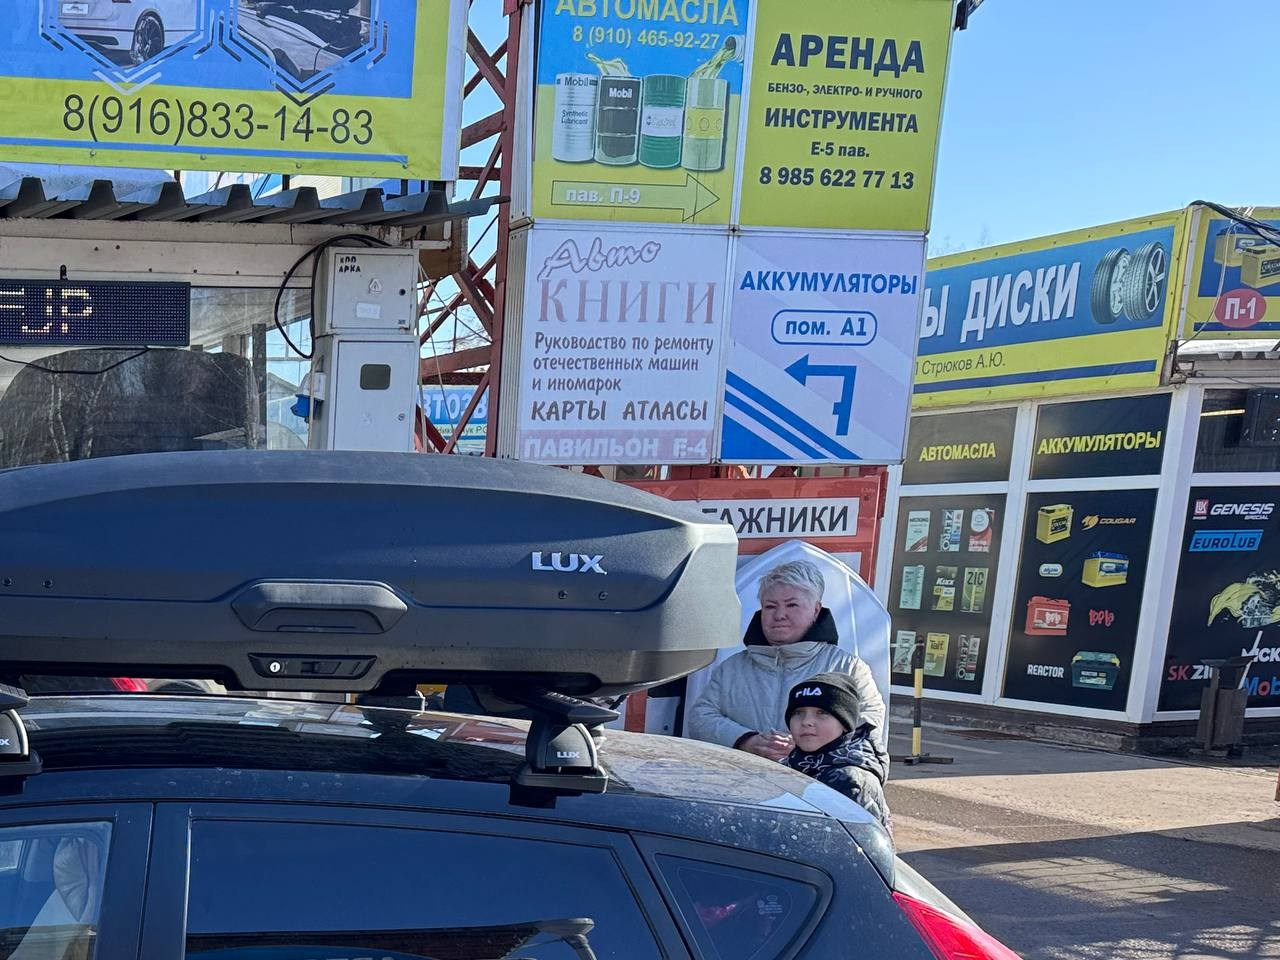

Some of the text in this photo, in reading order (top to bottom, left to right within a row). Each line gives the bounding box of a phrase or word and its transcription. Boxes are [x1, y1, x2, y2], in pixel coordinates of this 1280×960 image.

[555, 0, 739, 26] АВТОМАСЛА
[573, 25, 720, 49] 8 (910) 465-92-27
[770, 33, 925, 78] АРЕНДА
[564, 76, 588, 87] Mobil
[767, 83, 923, 99] БЕНЗО-, ЭЛЕКТРО- И РУЧНОГО
[609, 88, 633, 98] Mobil
[63, 94, 374, 146] 8(916)833-14-83
[765, 108, 918, 133] ИНСТРУМЕНТА
[838, 144, 870, 158] пав.
[759, 167, 914, 189] 8 985 622 77 13
[566, 187, 641, 203] пав. П-9
[339, 265, 361, 273] АРКА
[536, 237, 661, 283] Авто
[740, 271, 917, 295] АККУМУЛЯТОРЫ
[538, 278, 717, 324] КНИГИ
[960, 262, 1081, 343] ДИСКИ
[1224, 297, 1256, 320] П-1
[786, 317, 867, 336] пом. А1
[535, 332, 714, 355] Руководство по ремонту
[533, 355, 699, 371] отечественных машин
[921, 351, 1006, 377] Стрюков А.Ю.
[532, 376, 622, 394] и иномарок
[531, 400, 708, 421] КАРТЫ АТЛАСЫ
[524, 437, 659, 458] ПАВИЛЬОН
[920, 442, 996, 461] АВТОМАСЛА
[1038, 431, 1162, 455] АККУМУЛЯТОРЫ
[1210, 503, 1275, 516] GENESIS
[531, 551, 607, 575] LUX
[936, 577, 955, 585] Kixx
[967, 571, 984, 585] ZIC
[1027, 664, 1064, 678] REACTOR
[1168, 665, 1213, 680] SK ZI
[795, 687, 822, 698] FILA
[556, 751, 580, 759] LUX
